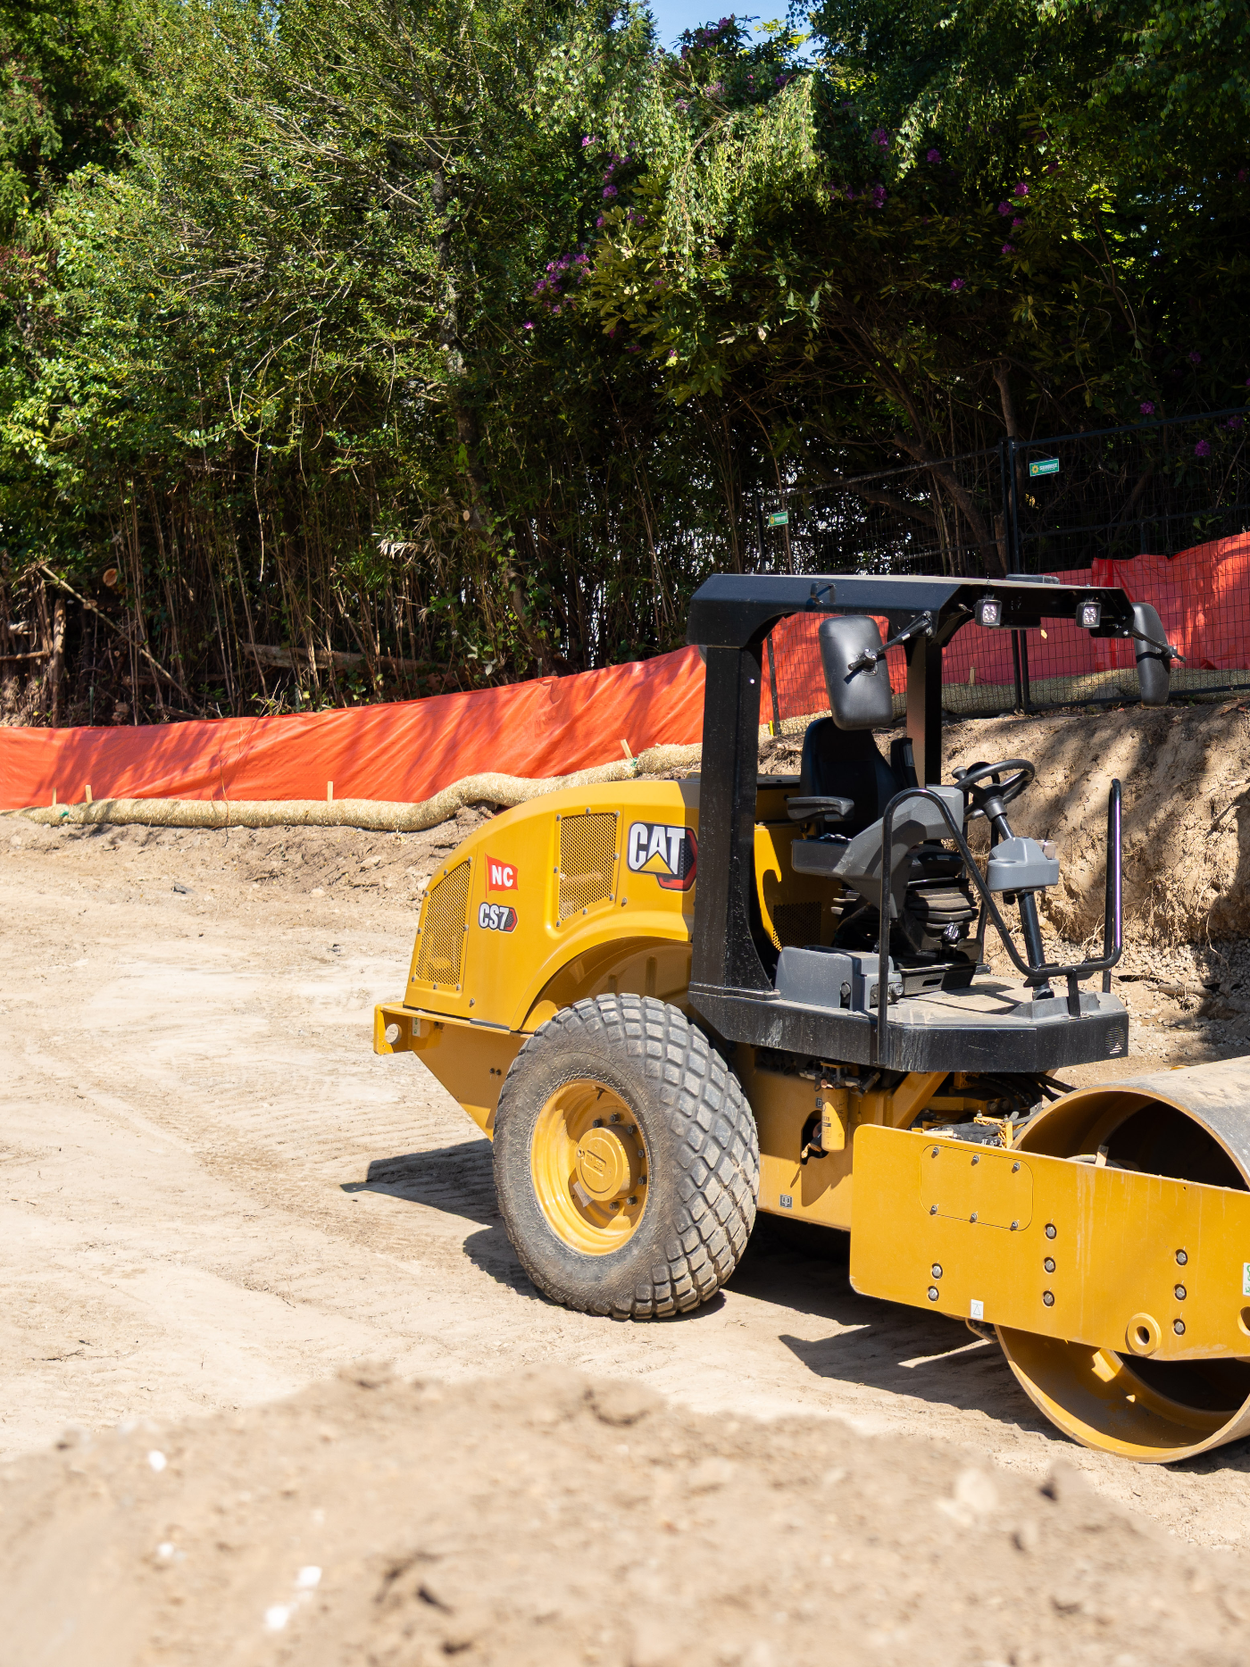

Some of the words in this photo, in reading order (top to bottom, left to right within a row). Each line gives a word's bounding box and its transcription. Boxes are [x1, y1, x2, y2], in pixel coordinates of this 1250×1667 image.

[628, 822, 686, 875] CAT
[491, 864, 514, 887] NC
[479, 902, 510, 930] CS7
